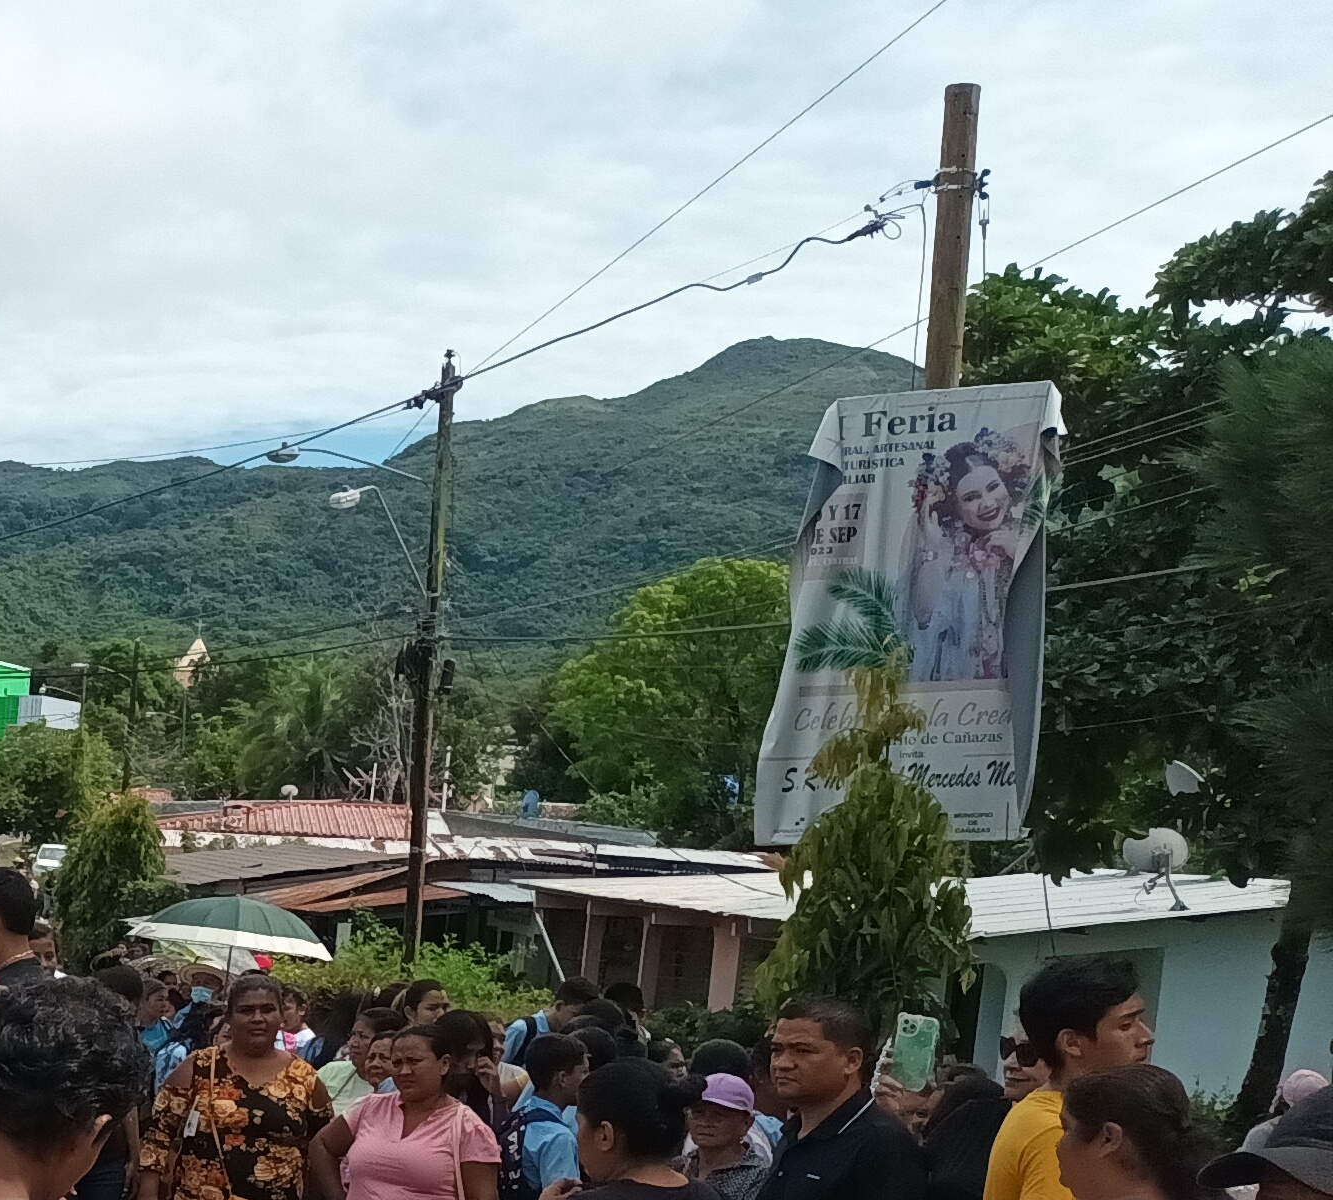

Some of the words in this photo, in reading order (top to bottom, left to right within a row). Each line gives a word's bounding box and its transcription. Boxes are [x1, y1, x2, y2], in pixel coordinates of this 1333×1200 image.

[861, 406, 957, 438] Feria
[873, 440, 937, 454] ARTESANAL
[843, 457, 905, 471] TURÍSTICA
[828, 505, 839, 521] Y
[844, 504, 862, 520] 17
[815, 528, 825, 545] E
[829, 526, 858, 544] SEP
[809, 547, 833, 556] 023
[920, 732, 939, 745] de
[942, 731, 1004, 744] Cañazas
[907, 761, 982, 788] Mercedes
